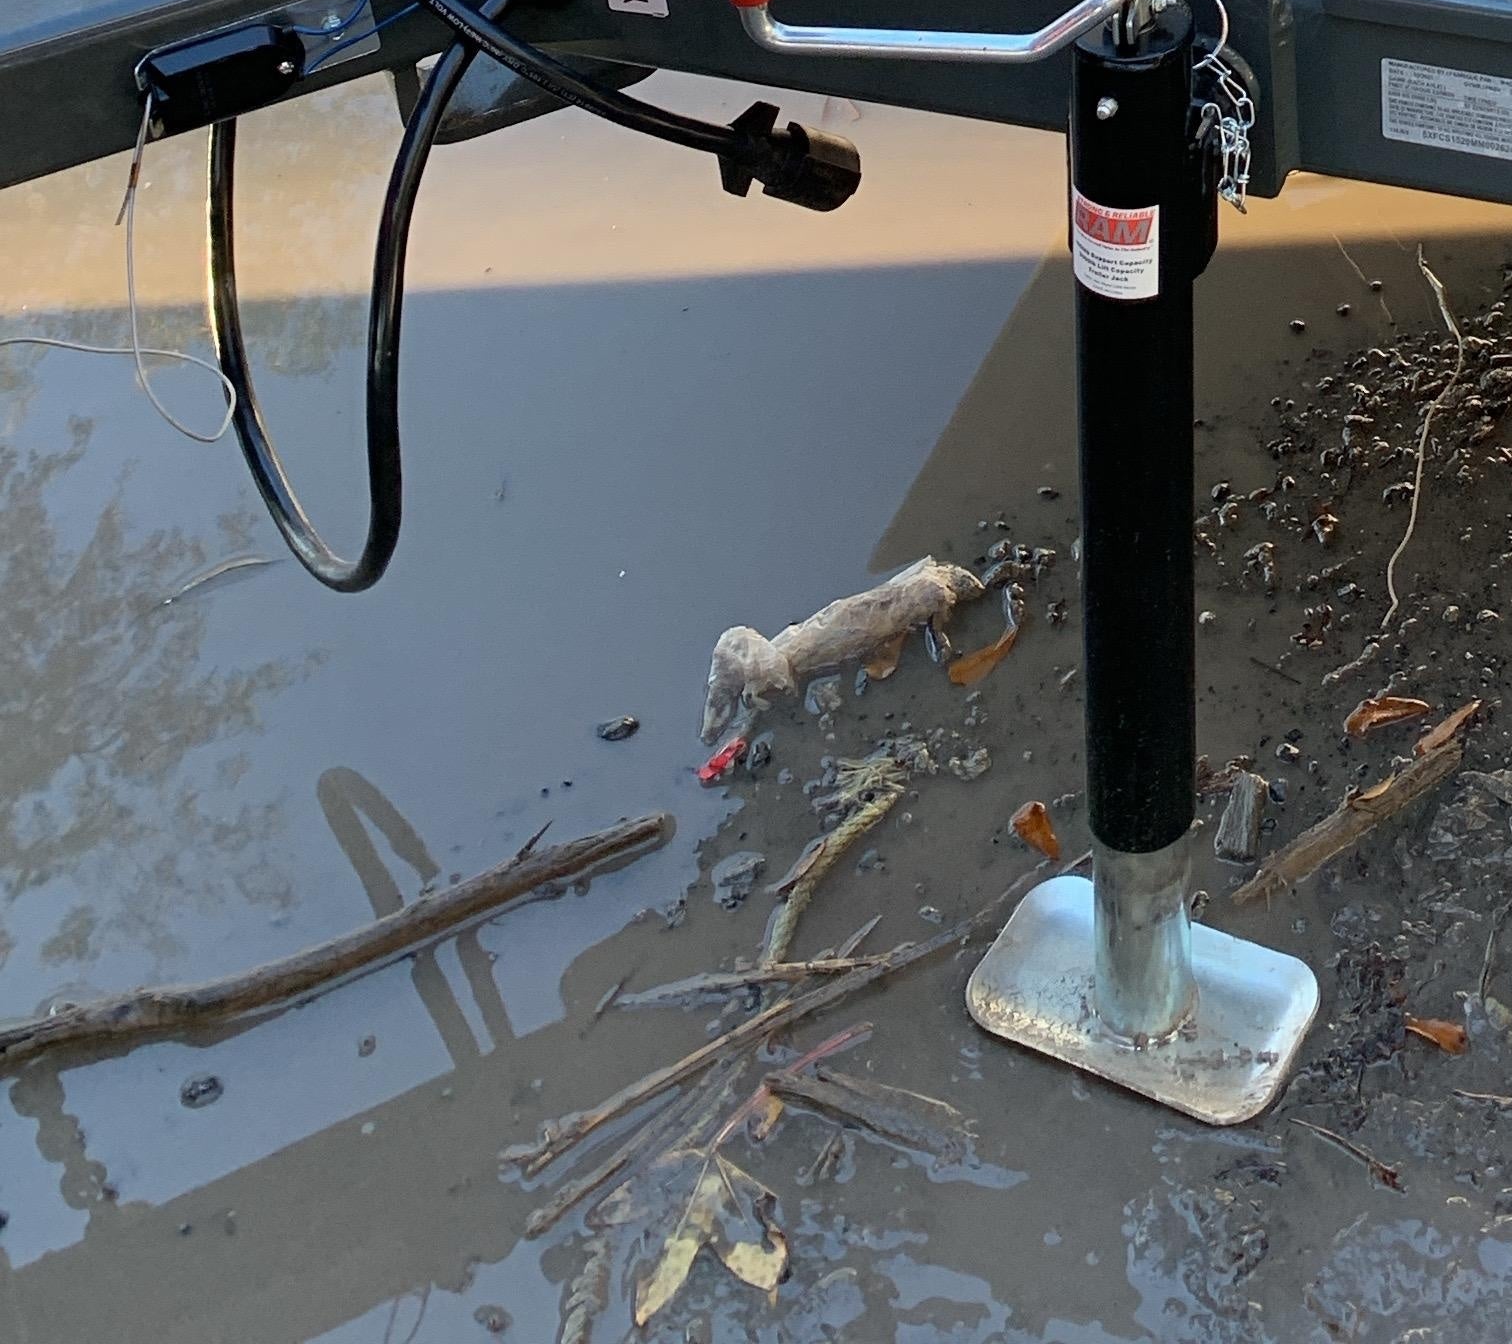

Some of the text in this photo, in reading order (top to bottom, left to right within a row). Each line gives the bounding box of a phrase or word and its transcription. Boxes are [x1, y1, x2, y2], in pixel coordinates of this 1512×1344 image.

[446, 11, 464, 29] LOW
[1077, 201, 1151, 245] RAM
[1119, 258, 1153, 267] Capacity
[1110, 267, 1145, 275] Capacity
